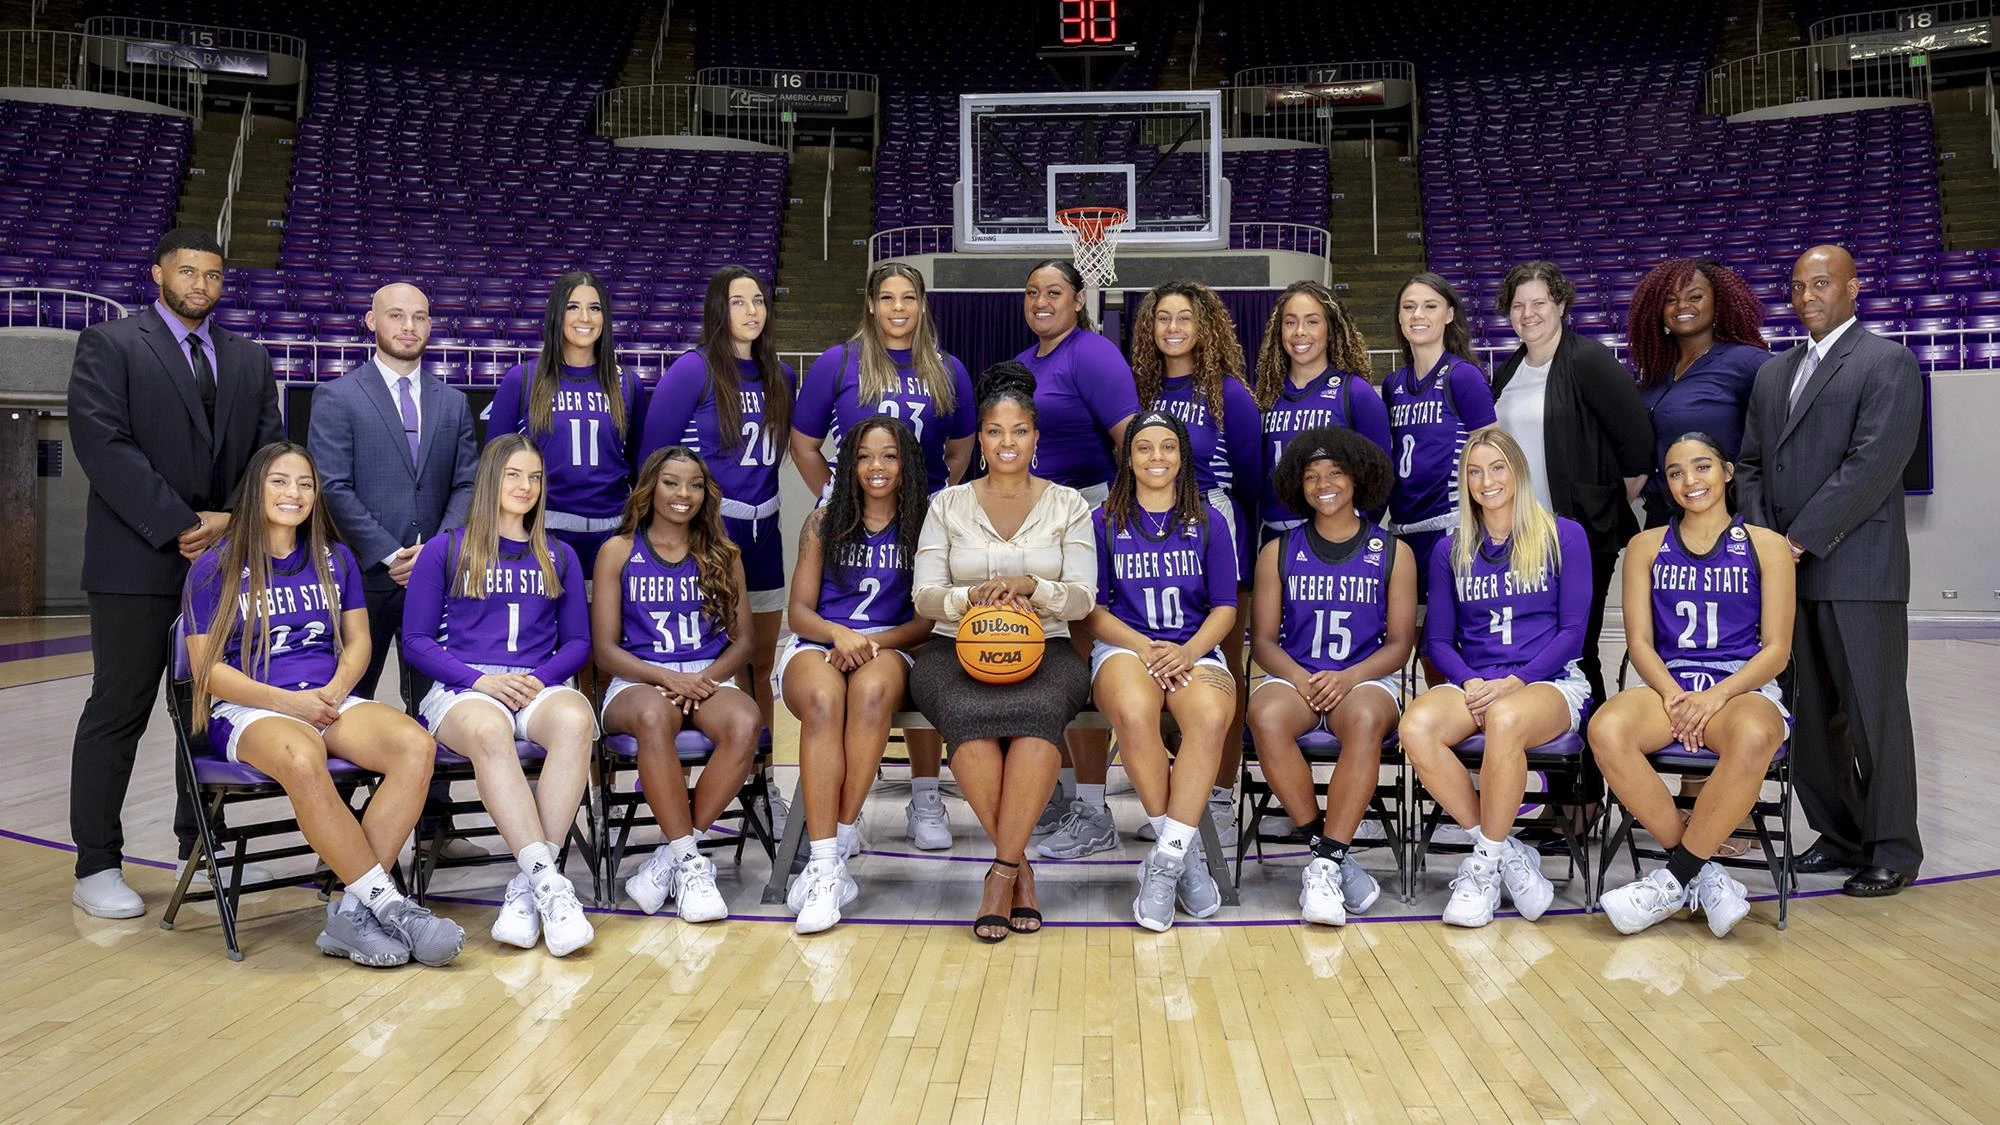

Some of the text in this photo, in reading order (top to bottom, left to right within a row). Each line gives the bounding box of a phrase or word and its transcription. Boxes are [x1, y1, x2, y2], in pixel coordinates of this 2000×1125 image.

[1061, 0, 1116, 43] 30
[1907, 12, 1932, 29] 18
[189, 30, 214, 47] 15
[203, 53, 251, 67] BANK
[781, 74, 802, 88] 16
[1317, 69, 1337, 83] 17
[779, 93, 843, 103] AMERICA FIRST
[907, 376, 930, 397] STA
[552, 391, 610, 414] BER STA
[740, 392, 761, 413] BER
[1170, 401, 1205, 426] STATE
[1390, 401, 1443, 428] EBER STATE
[878, 400, 926, 443] 23
[1262, 409, 1332, 434] EBER STATE
[569, 418, 600, 466] 11
[740, 421, 776, 466] 20
[1399, 434, 1416, 478] 0
[834, 543, 911, 570] EBER STAT
[1114, 552, 1160, 579] WEBER
[463, 568, 545, 597] WBER STA
[629, 575, 705, 602] WEBER STA
[1288, 575, 1333, 601] WEBER
[1456, 573, 1499, 602] WEBER
[1653, 564, 1749, 594] WEBER STATE
[299, 583, 342, 611] STAE
[848, 577, 881, 621] 2
[1142, 586, 1184, 630] 10
[507, 602, 520, 652] 1
[648, 610, 702, 653] 34
[971, 617, 1029, 636] Wilson
[1311, 609, 1353, 661] 15
[1489, 606, 1513, 645] 4
[1675, 600, 1718, 649] 21
[978, 650, 1022, 664] NCAA
